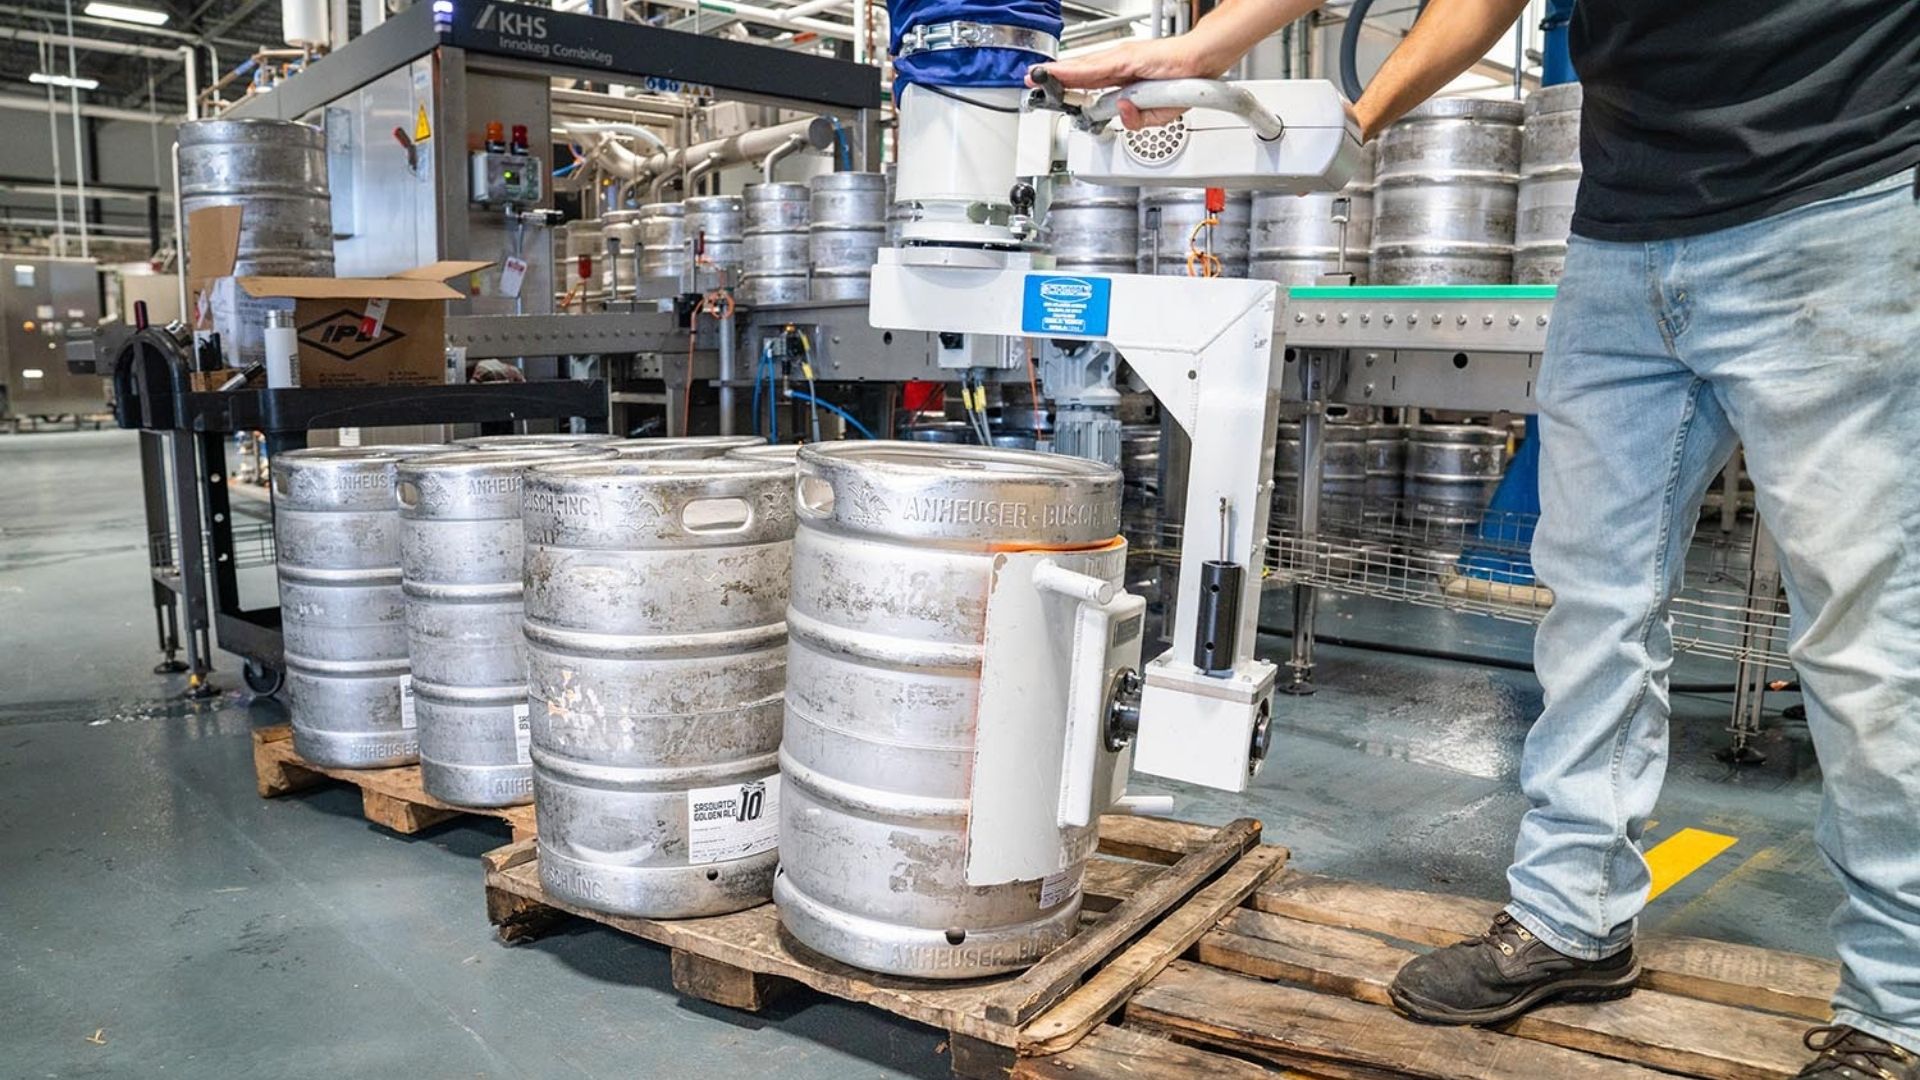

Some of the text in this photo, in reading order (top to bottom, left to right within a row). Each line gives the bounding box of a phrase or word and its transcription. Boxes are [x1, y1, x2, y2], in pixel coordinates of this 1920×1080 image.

[499, 11, 547, 39] KHS
[499, 36, 550, 58] Innokeg
[693, 799, 737, 813] SASQUATCH
